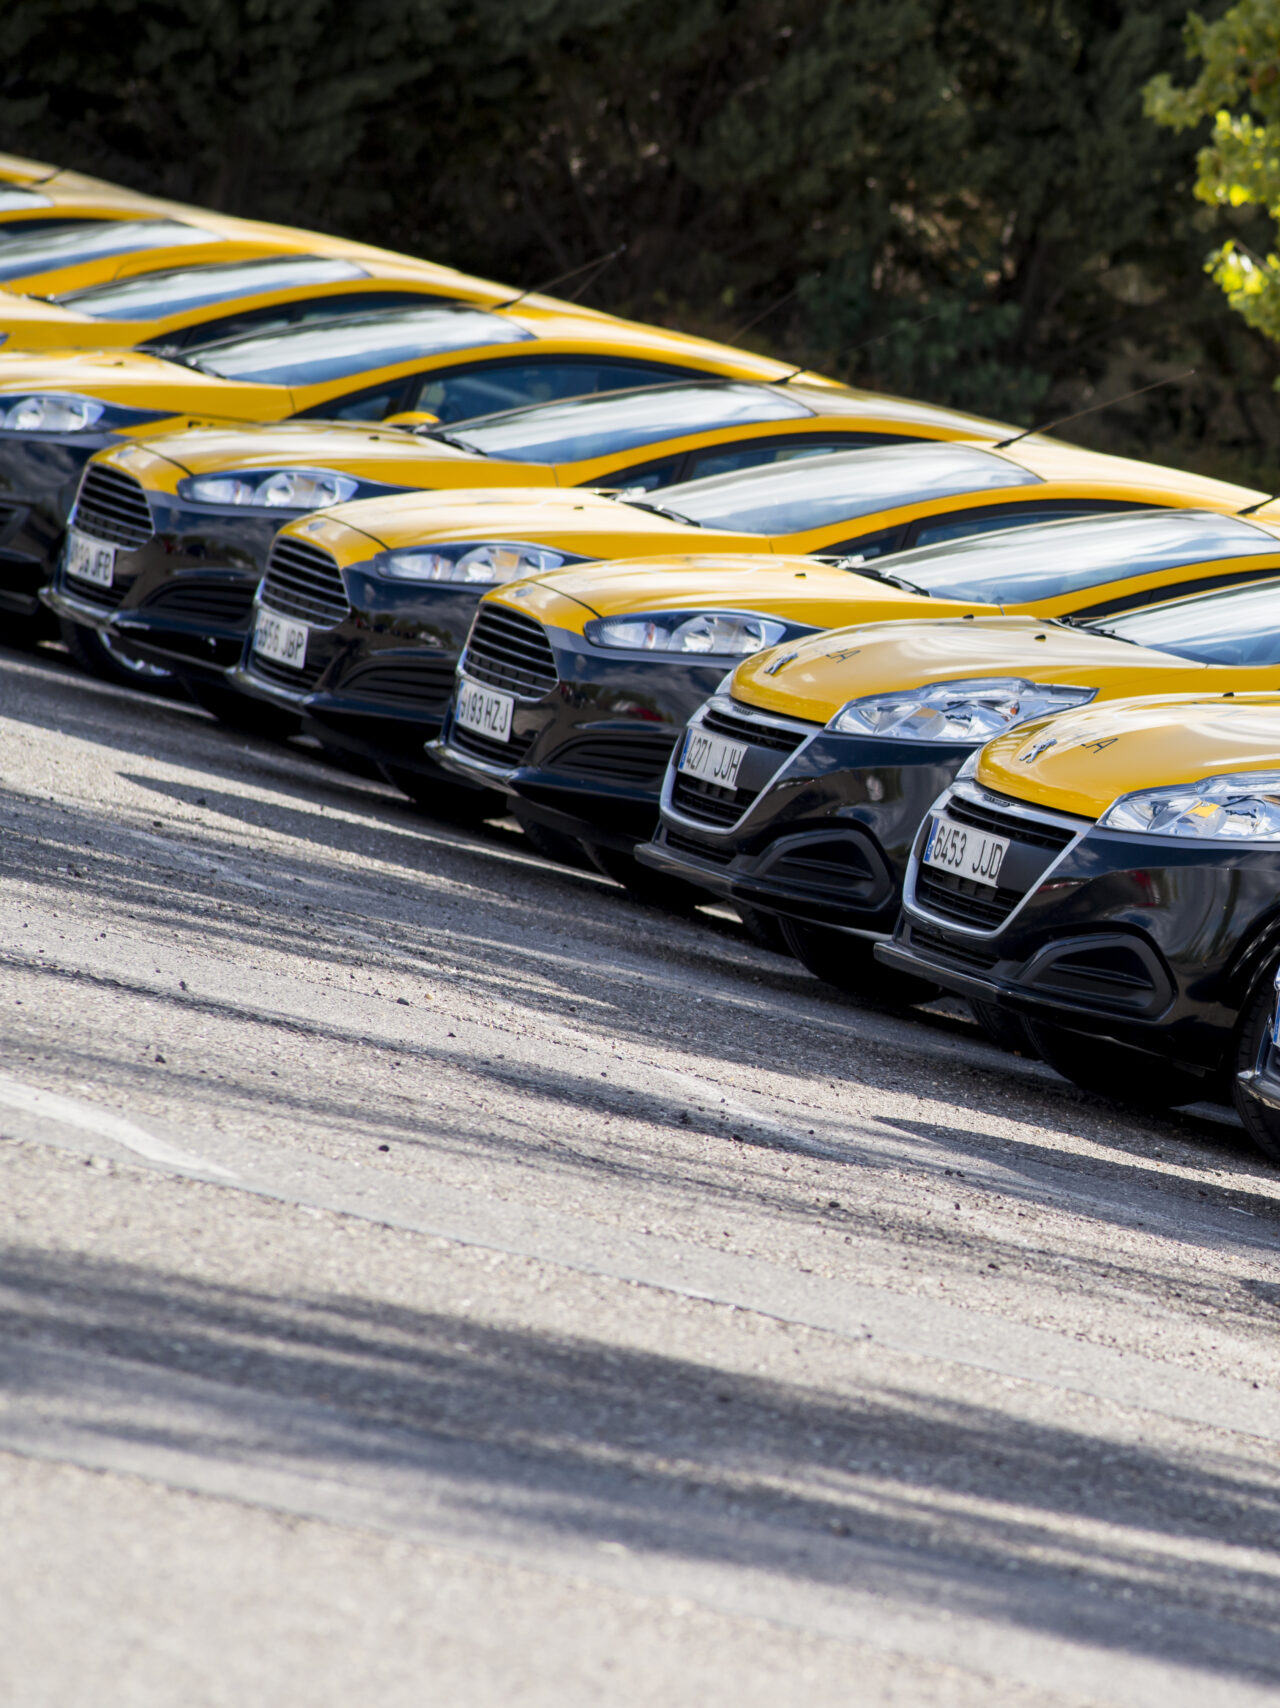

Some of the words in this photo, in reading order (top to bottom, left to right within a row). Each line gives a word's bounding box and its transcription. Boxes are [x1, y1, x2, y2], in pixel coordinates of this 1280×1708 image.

[484, 697, 509, 733] HZJ
[714, 745, 742, 783] JJH
[933, 825, 967, 868] 6453
[972, 839, 1003, 880] JJD
